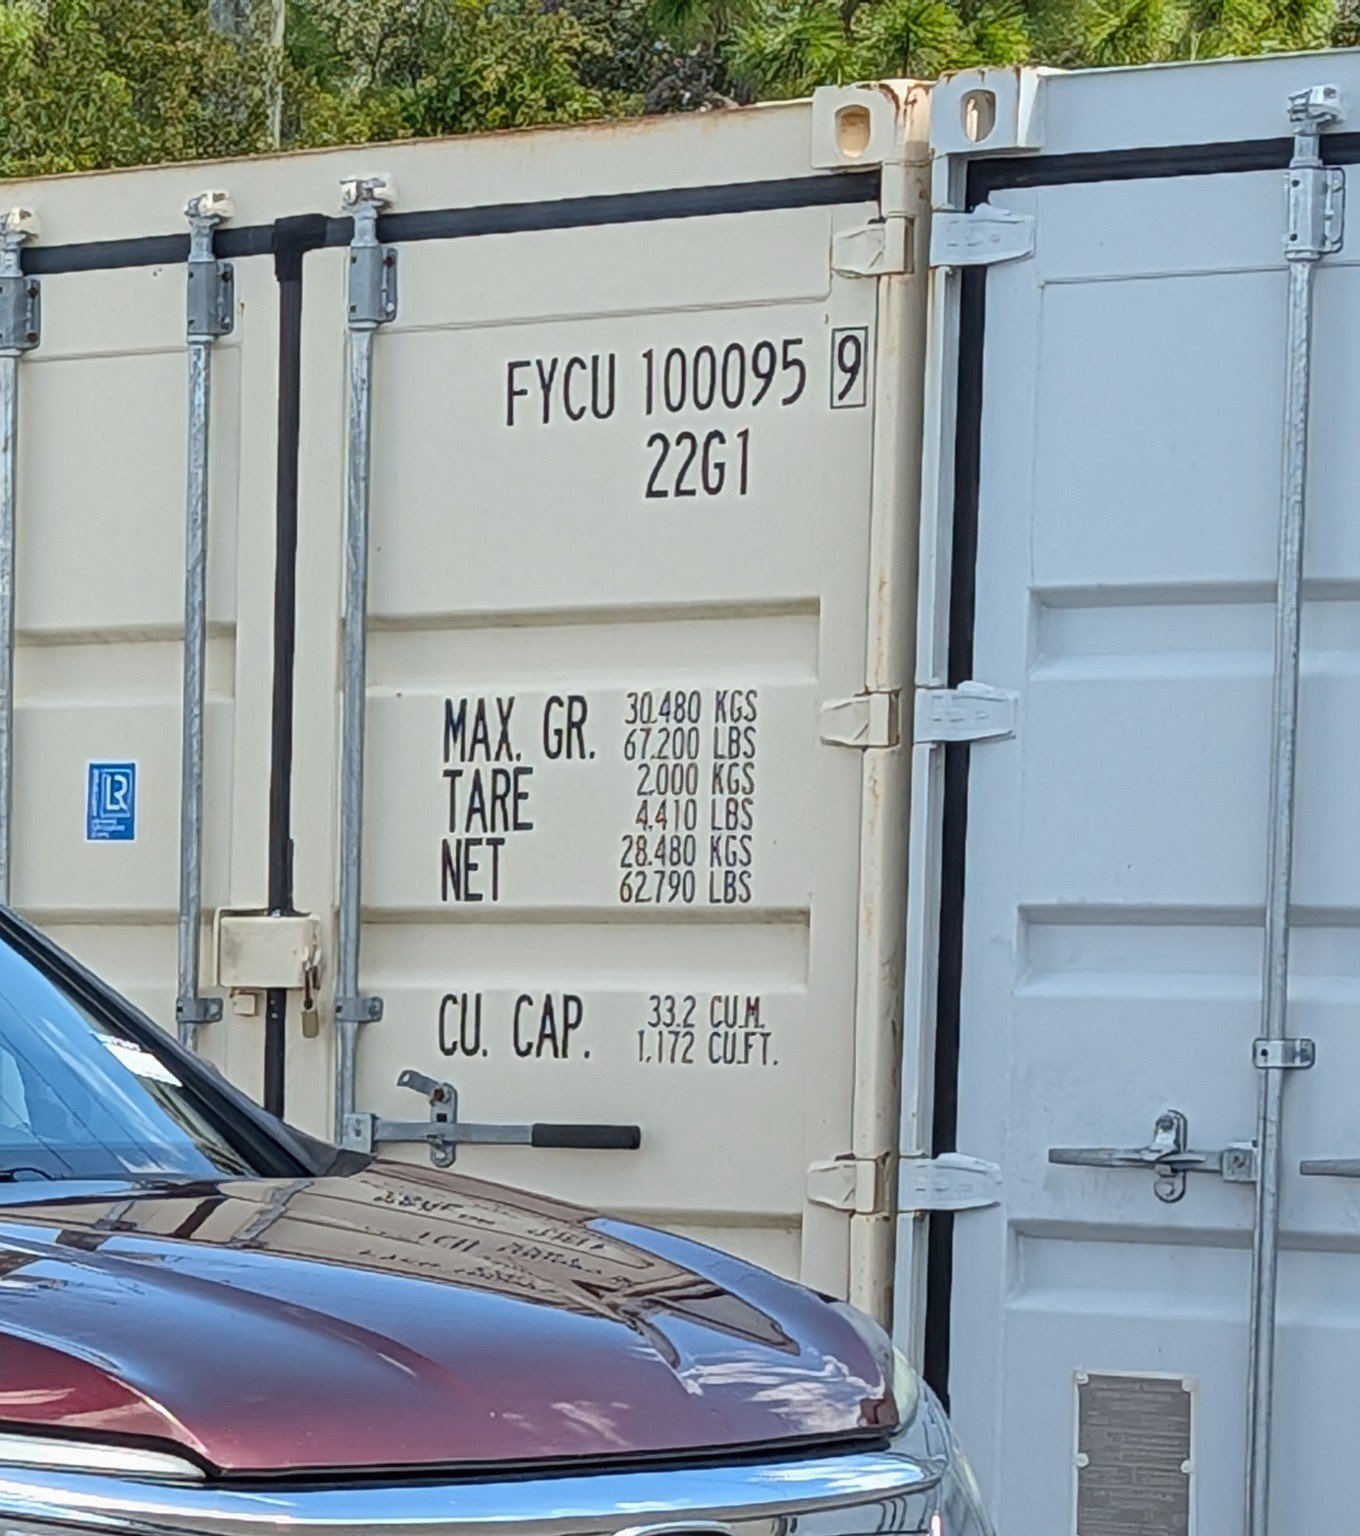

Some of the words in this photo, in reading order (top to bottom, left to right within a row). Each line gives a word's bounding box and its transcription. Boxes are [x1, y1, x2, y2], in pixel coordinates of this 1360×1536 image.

[506, 352, 616, 427] FYCU
[642, 337, 807, 416] 100095
[836, 333, 863, 402] 9
[645, 427, 750, 499] 22G1
[714, 689, 758, 724] KGS
[443, 695, 523, 764] MAX.
[543, 694, 596, 760] GR.
[713, 725, 757, 760] LBS
[711, 761, 755, 796] KGS
[442, 766, 534, 834] TARE
[710, 797, 754, 831] LBS
[709, 834, 753, 868] KGS
[441, 837, 506, 902] NET
[709, 869, 752, 904] LBS
[438, 992, 488, 1058] CU.
[512, 993, 591, 1059] CAP.
[647, 994, 697, 1029] 33.2
